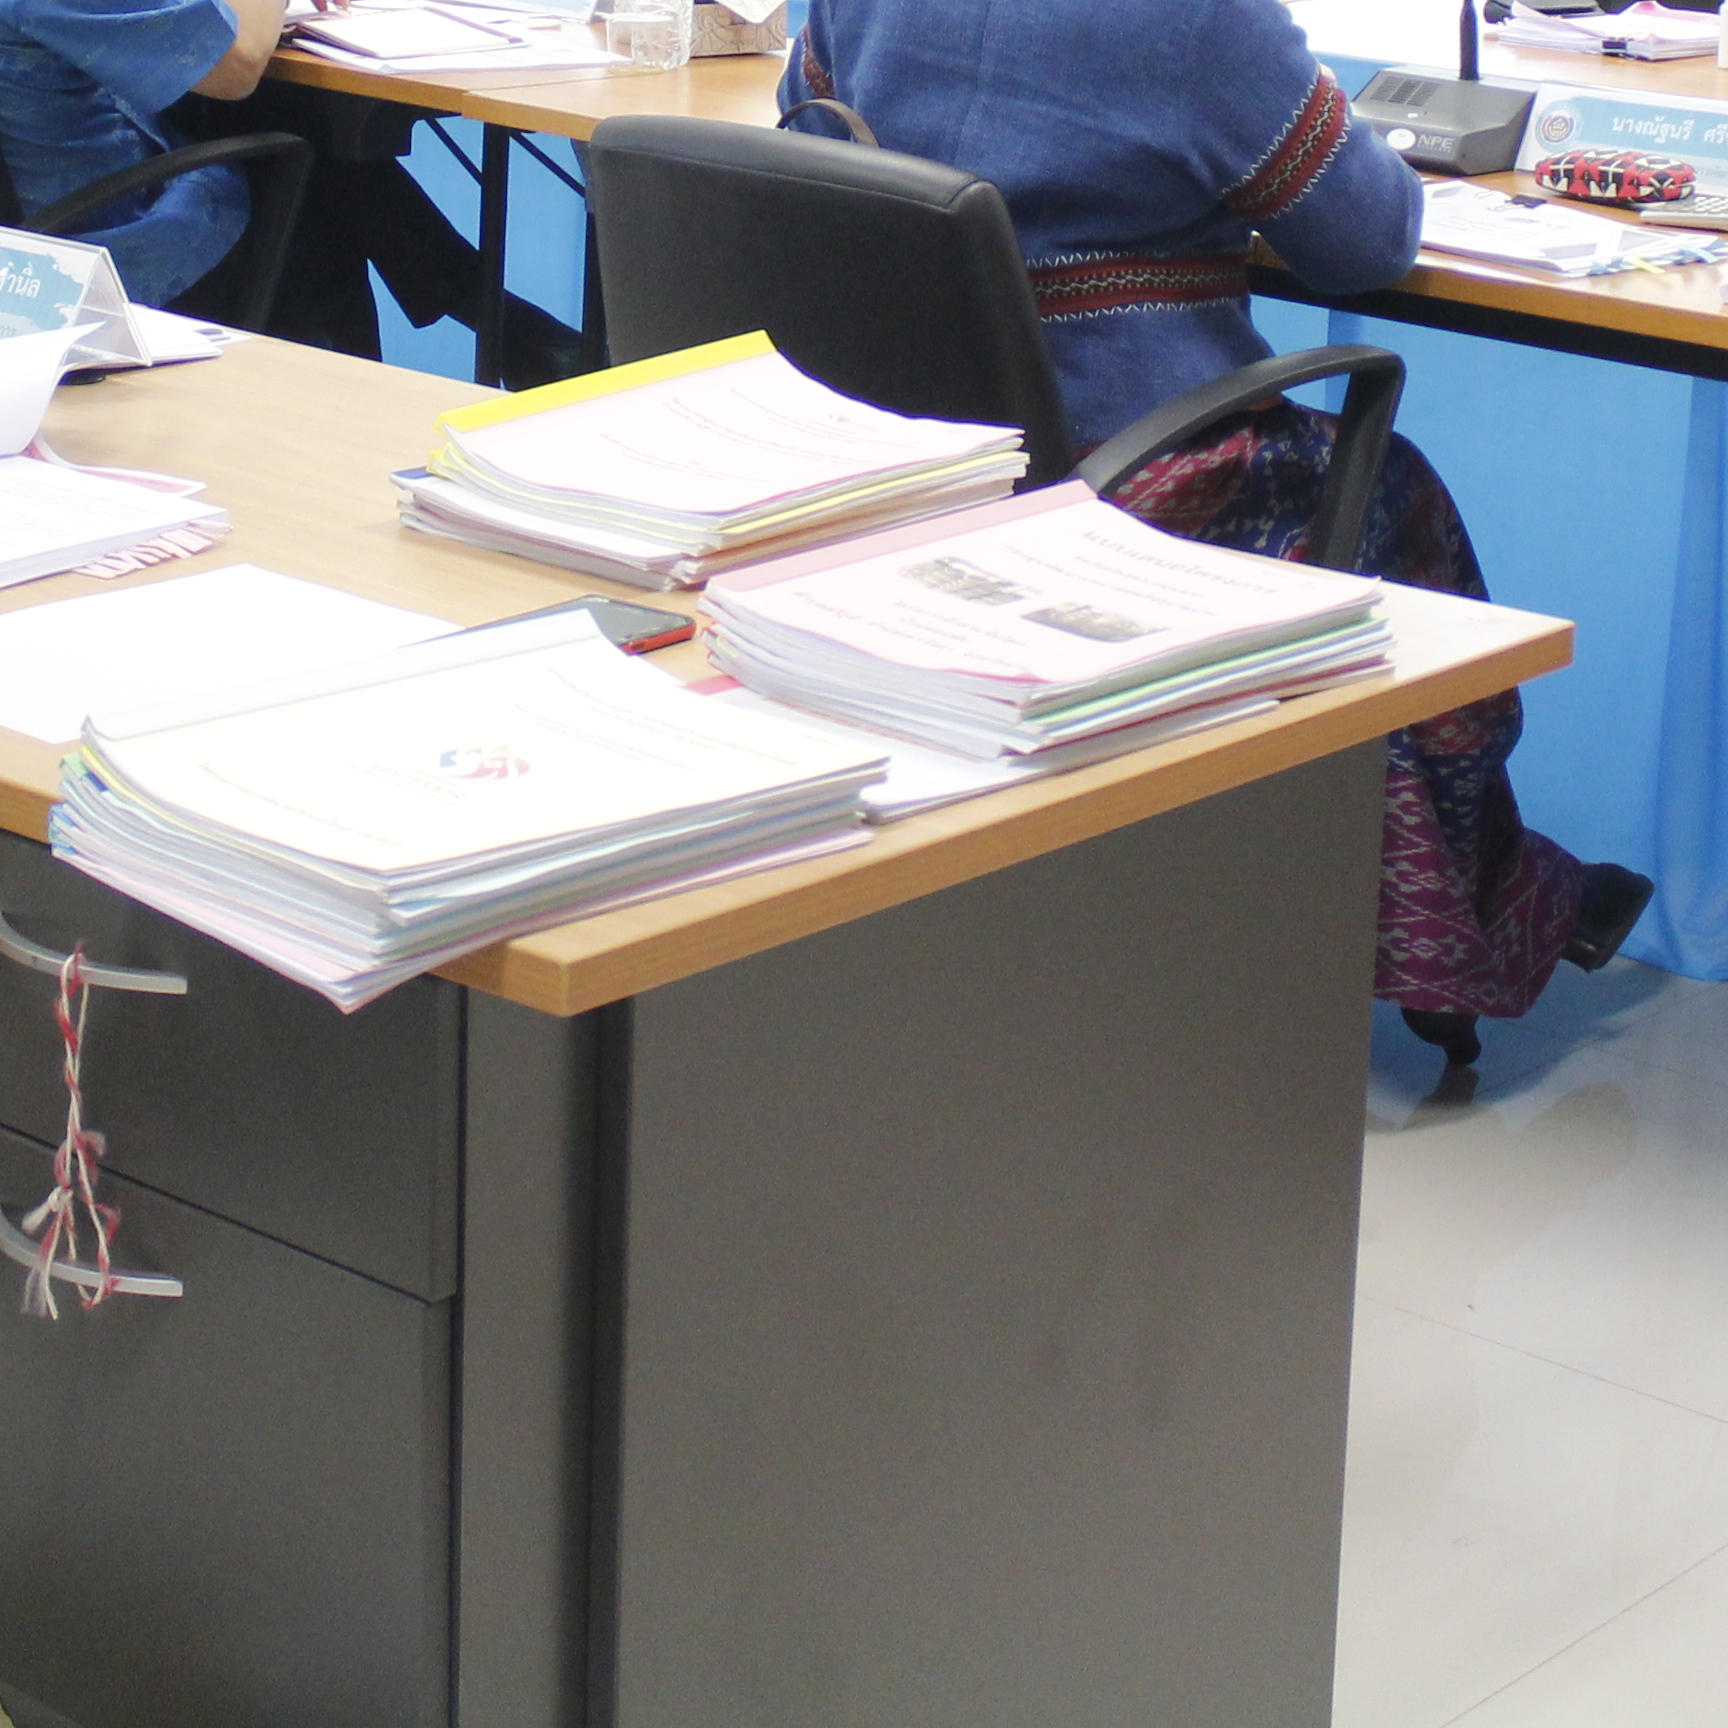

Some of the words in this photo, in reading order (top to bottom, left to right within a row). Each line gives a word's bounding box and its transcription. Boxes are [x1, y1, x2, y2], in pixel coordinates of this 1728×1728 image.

[1613, 113, 1694, 145] นางณัฐนรี
[1418, 134, 1455, 149] NPE
